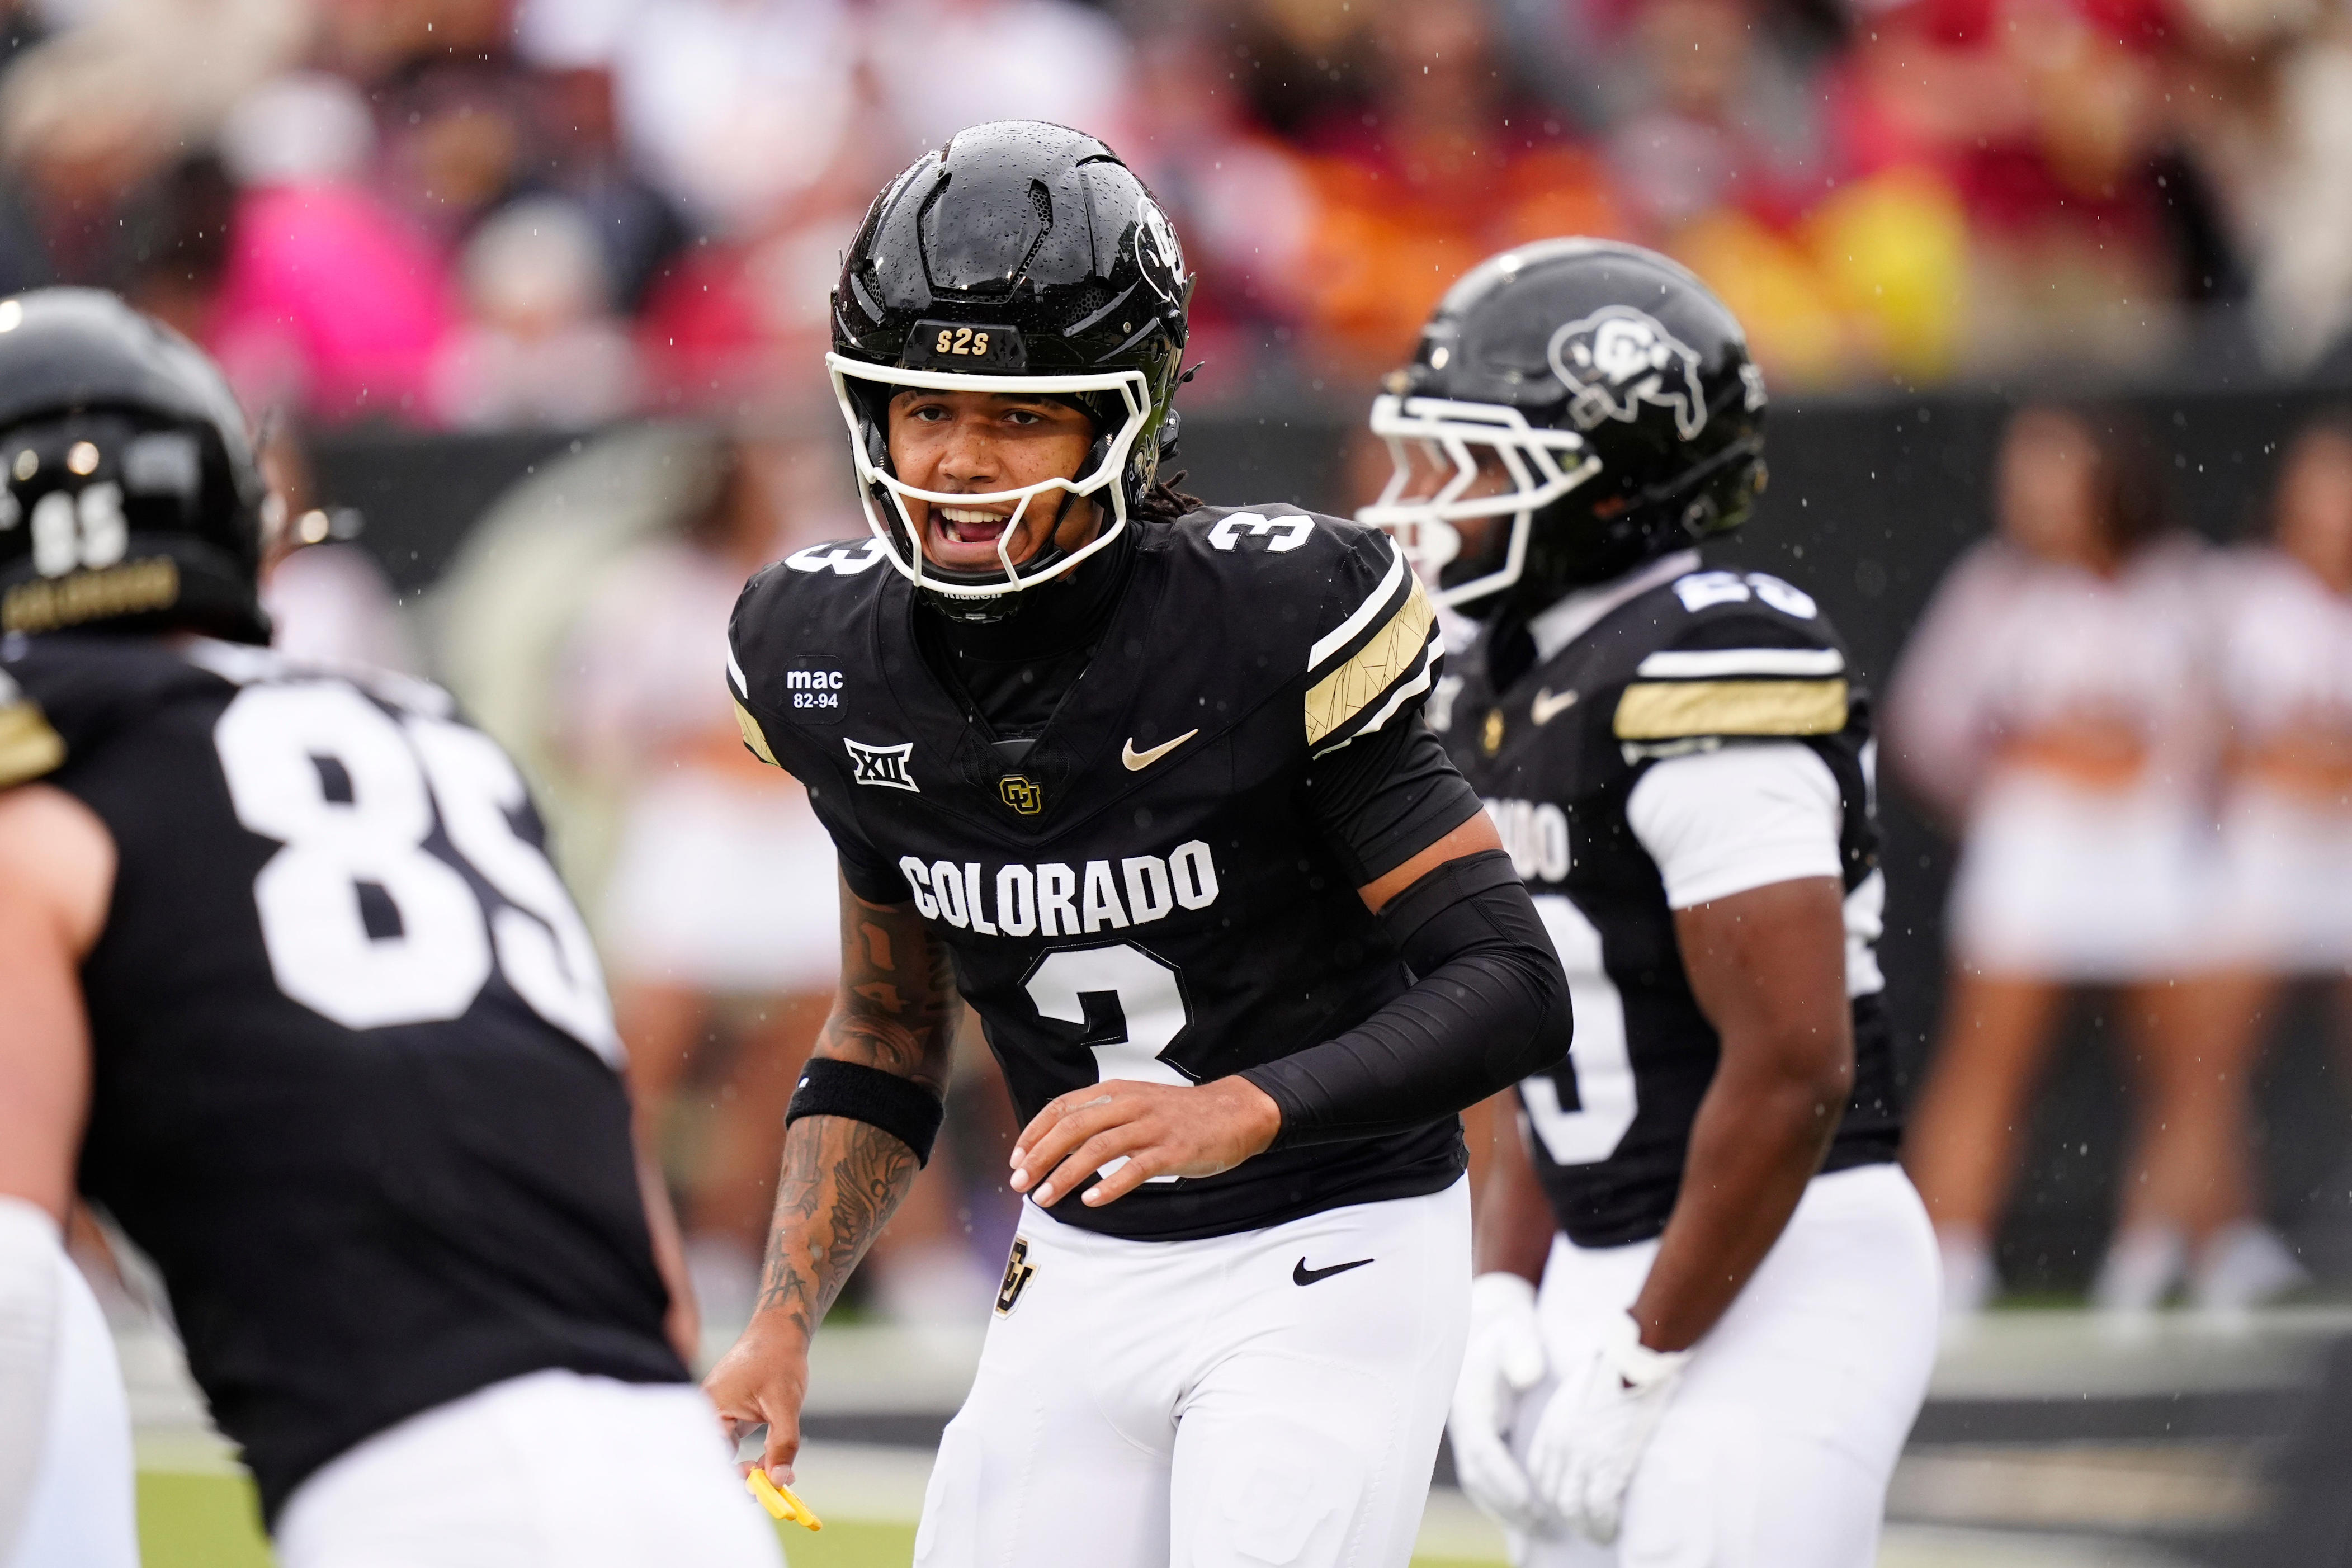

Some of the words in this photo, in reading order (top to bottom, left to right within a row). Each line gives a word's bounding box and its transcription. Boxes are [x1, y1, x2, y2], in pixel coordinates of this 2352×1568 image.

[1207, 511, 1315, 550] 3
[787, 670, 843, 689] mac
[794, 693, 838, 709] 82-94
[999, 776, 1041, 814] CU
[213, 679, 627, 1071] 85
[899, 839, 1220, 937] COLORADO
[1024, 943, 1195, 1183] 3
